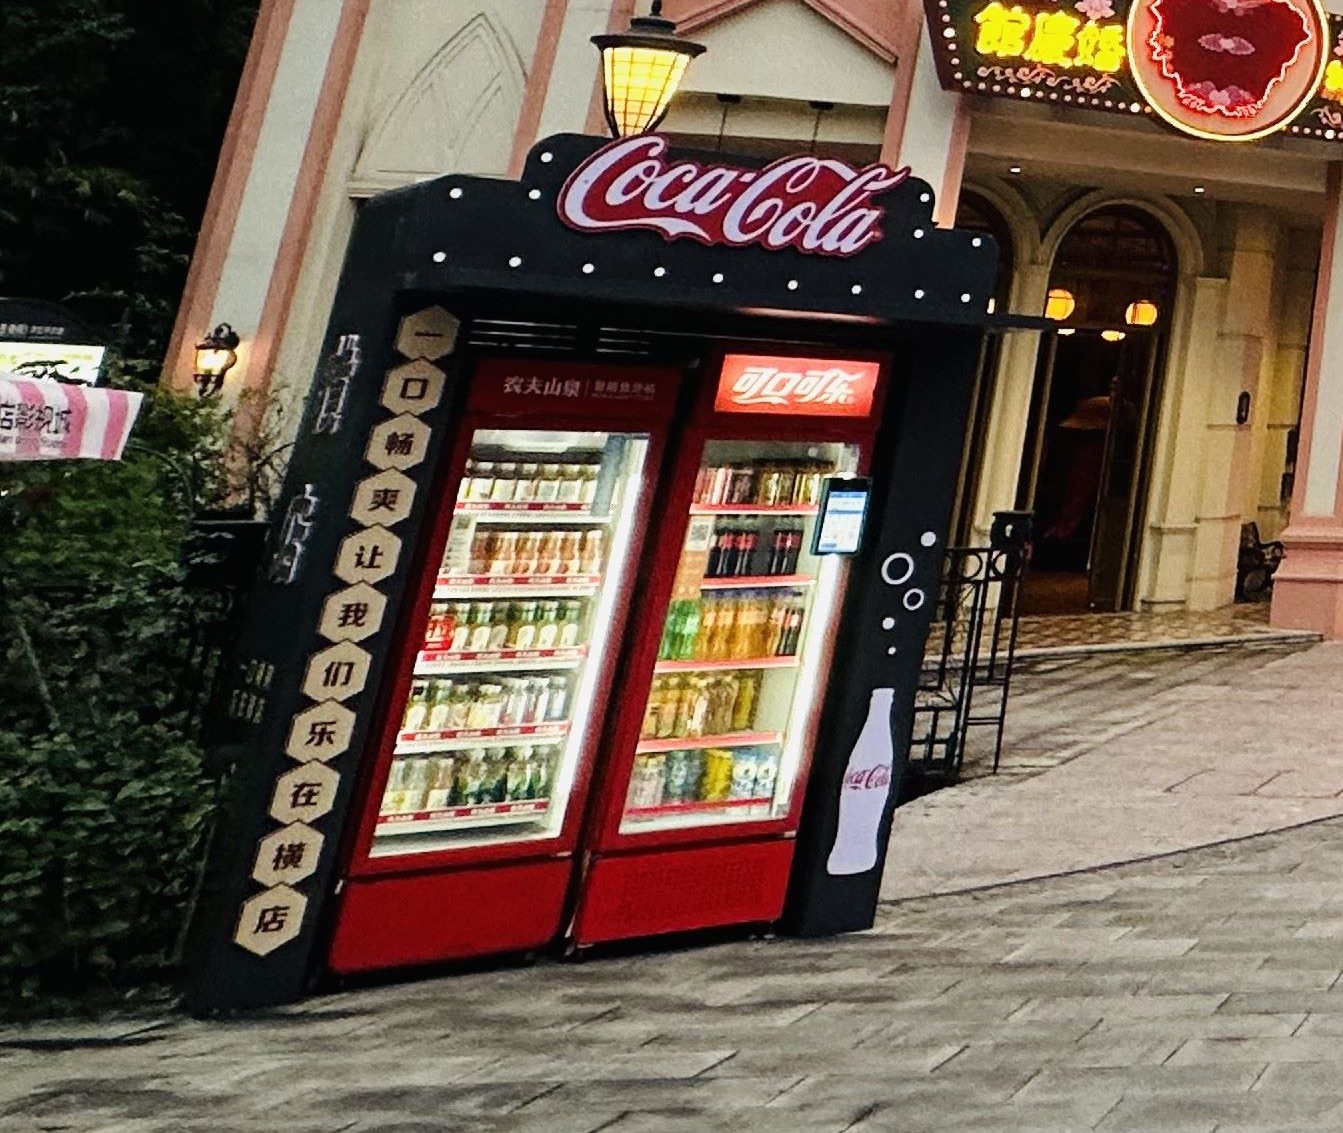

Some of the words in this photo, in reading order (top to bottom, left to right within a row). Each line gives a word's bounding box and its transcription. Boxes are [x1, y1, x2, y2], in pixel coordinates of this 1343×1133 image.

[564, 135, 906, 254] Coca-Cola
[503, 376, 581, 397] 农夫山泉
[732, 366, 864, 407] 可口可乐
[253, 331, 443, 934] 一口畅爽让我们乐在横店
